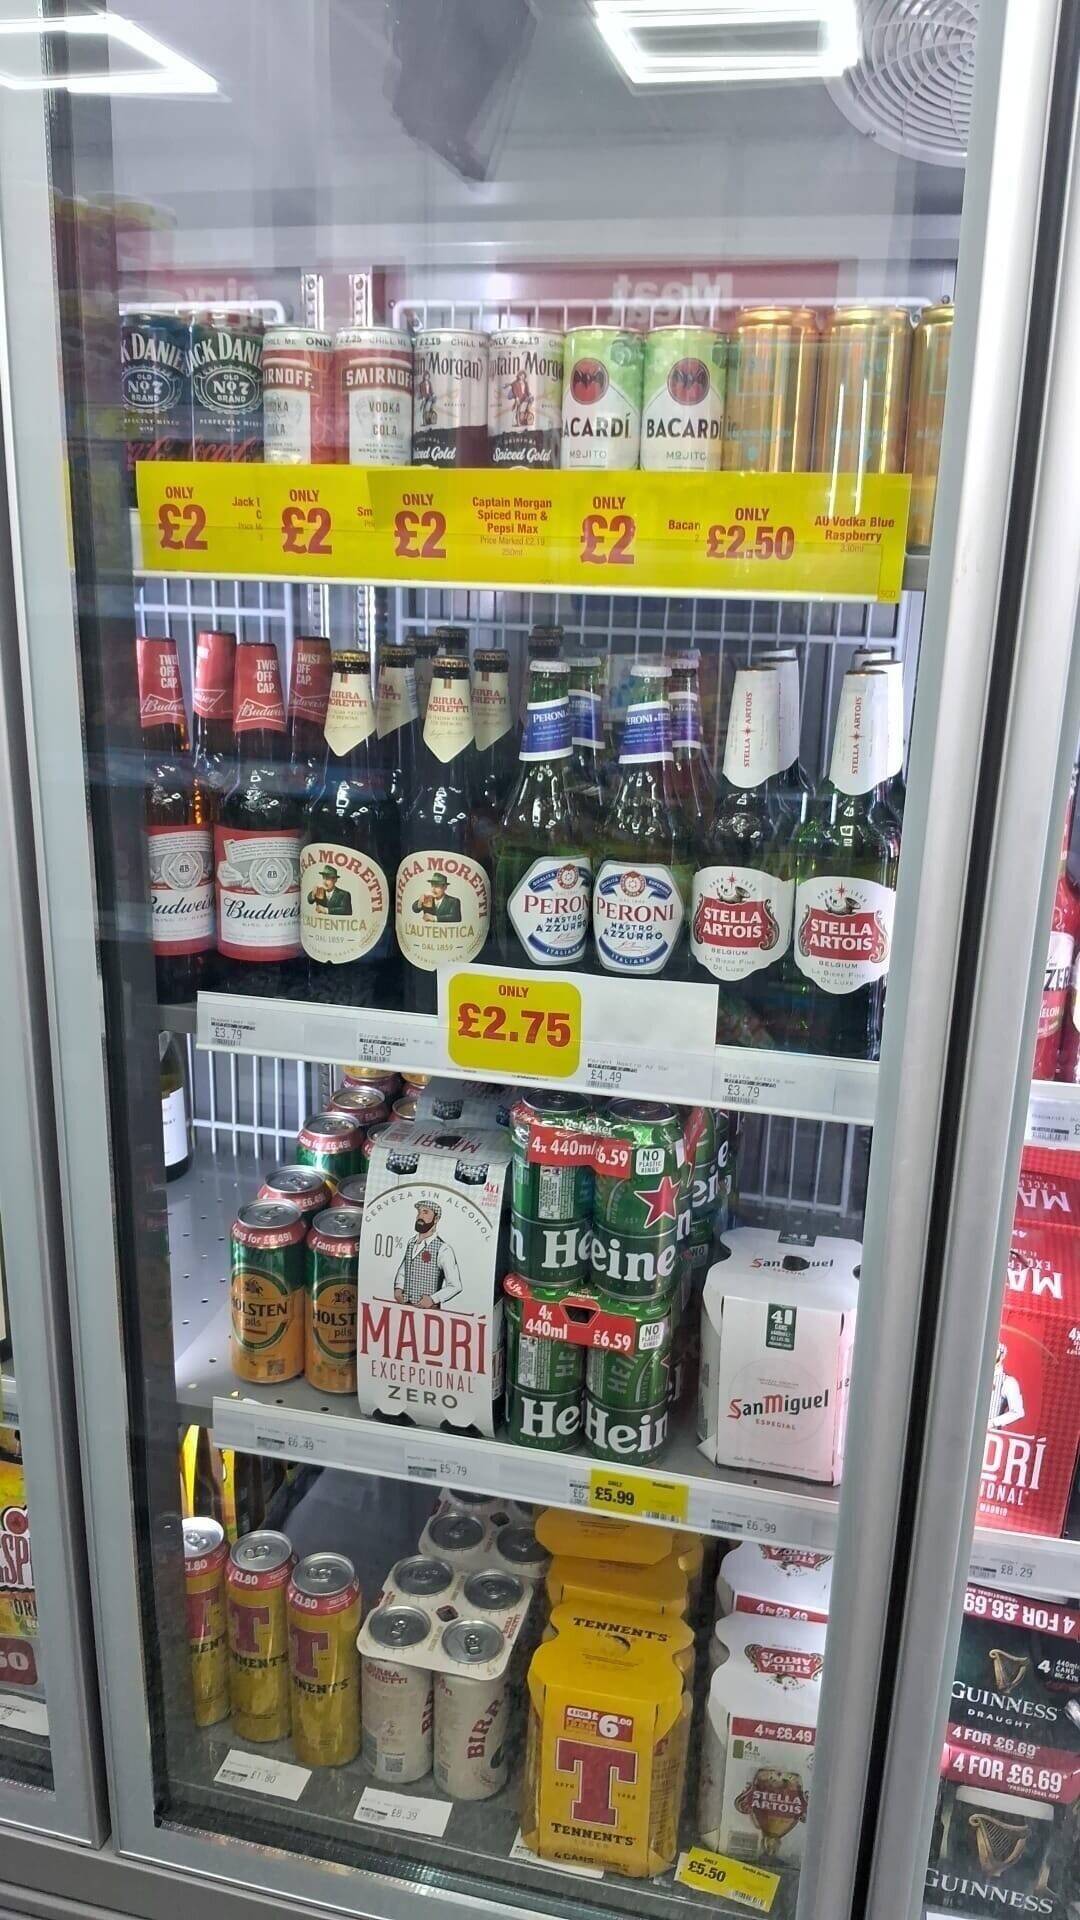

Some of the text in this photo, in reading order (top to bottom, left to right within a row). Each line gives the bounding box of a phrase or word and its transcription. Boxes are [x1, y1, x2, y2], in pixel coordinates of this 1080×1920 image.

[305, 338, 332, 347] ONLY
[428, 352, 478, 380] Morgan
[132, 394, 159, 402] BRAND
[369, 401, 401, 413] VODKA
[373, 424, 398, 435] COLA
[431, 446, 457, 461] Gold
[493, 448, 552, 462] Spiced Gold
[569, 450, 607, 460] MOJITO
[666, 451, 707, 461] MOJITO
[165, 486, 194, 499] ONLY
[289, 489, 320, 502] ONLY
[402, 493, 434, 506] ONLY
[232, 497, 255, 508] Jack
[472, 496, 553, 510] Captain Morgan
[593, 496, 626, 510] ONLY
[477, 509, 548, 522] Spiced Rum &
[735, 507, 770, 521] ONLY
[158, 503, 209, 551] £2
[814, 516, 895, 528] AU Vodka Blue
[281, 506, 333, 555] £2
[394, 510, 447, 559] £2
[487, 523, 539, 536] Pepsi Max
[825, 530, 882, 543] Raspberry
[580, 514, 635, 565] £2
[706, 524, 795, 560] £2.50
[297, 652, 321, 664] TWIST
[160, 666, 175, 677] OFF
[297, 664, 311, 674] OFF
[256, 672, 273, 682] OFF
[256, 683, 277, 694] CAP.
[331, 690, 360, 700] BIRRA
[433, 696, 464, 705] BIRRA
[533, 711, 566, 723] PERONI
[851, 696, 862, 775] STELLA ARTOIS
[318, 849, 384, 913] MORETTI
[427, 857, 488, 919] MORETTI
[596, 896, 674, 923] PERONI
[703, 906, 763, 924] STELLA
[546, 913, 583, 924] NASTRO
[404, 922, 475, 938] L'AUTENTICA
[535, 919, 587, 933] AZZURRO
[610, 922, 653, 932] NASTRO
[702, 921, 763, 939] ARTOIS
[810, 918, 874, 936] STELLA
[603, 930, 664, 941] AZZURRO
[808, 934, 874, 951] ARTOIS
[710, 947, 749, 956] BELGIUM
[818, 960, 859, 969] BELGIUM
[498, 984, 530, 999] ONLY
[457, 1002, 572, 1049] £2.75
[214, 1027, 243, 1041] £3.79
[362, 1044, 392, 1057] £4.09
[590, 1069, 623, 1083] £4.49
[727, 1085, 760, 1098] £3.79
[531, 1136, 596, 1156] 4x 440ml
[642, 1150, 660, 1161] NO
[364, 1190, 492, 1242] CERVEZA SIN ALCOHOL
[248, 1234, 262, 1244] for
[374, 1233, 403, 1258] 0.0%
[317, 1241, 352, 1253] cans for
[589, 1237, 676, 1282] eine
[538, 1304, 553, 1321] 4x
[770, 1308, 783, 1324] 4
[245, 1317, 262, 1328] pils
[525, 1318, 568, 1339] 440ml
[644, 1324, 660, 1335] NO
[334, 1327, 353, 1338] pils
[360, 1301, 487, 1375] MADRÍ
[592, 1330, 632, 1351] £6.59
[371, 1359, 475, 1394] EXCEPCIONAL
[388, 1384, 458, 1409] ZERO
[727, 1389, 830, 1420] SanMiguel
[520, 1396, 581, 1439] He
[755, 1419, 797, 1430] ESPECIAL
[440, 1463, 468, 1477] £5.79
[594, 1486, 635, 1506] £5.99
[746, 1520, 777, 1534] £6.99
[232, 1570, 258, 1586] £1.80
[1000, 1564, 1033, 1579] £8.29
[295, 1592, 318, 1609] £1.80
[964, 1592, 1076, 1634] 4 FOR £6.69
[762, 1660, 811, 1674] STELLA
[1037, 1659, 1051, 1673] 4
[1055, 1667, 1075, 1675] CANS
[951, 1680, 1058, 1722] GUINNESS
[967, 1708, 1033, 1729] DRAUGHT
[754, 1723, 813, 1743] 4 For £6.49
[952, 1726, 992, 1747] 4 FOR
[953, 1755, 1004, 1781] 4 FOR
[556, 1737, 638, 1827] T
[752, 1789, 802, 1805] STELLA
[751, 1800, 802, 1815] ARTOIS
[553, 1850, 595, 1865] 4 CANS
[687, 1859, 727, 1883] £5.50
[925, 1868, 1054, 1915] GUINNESS
